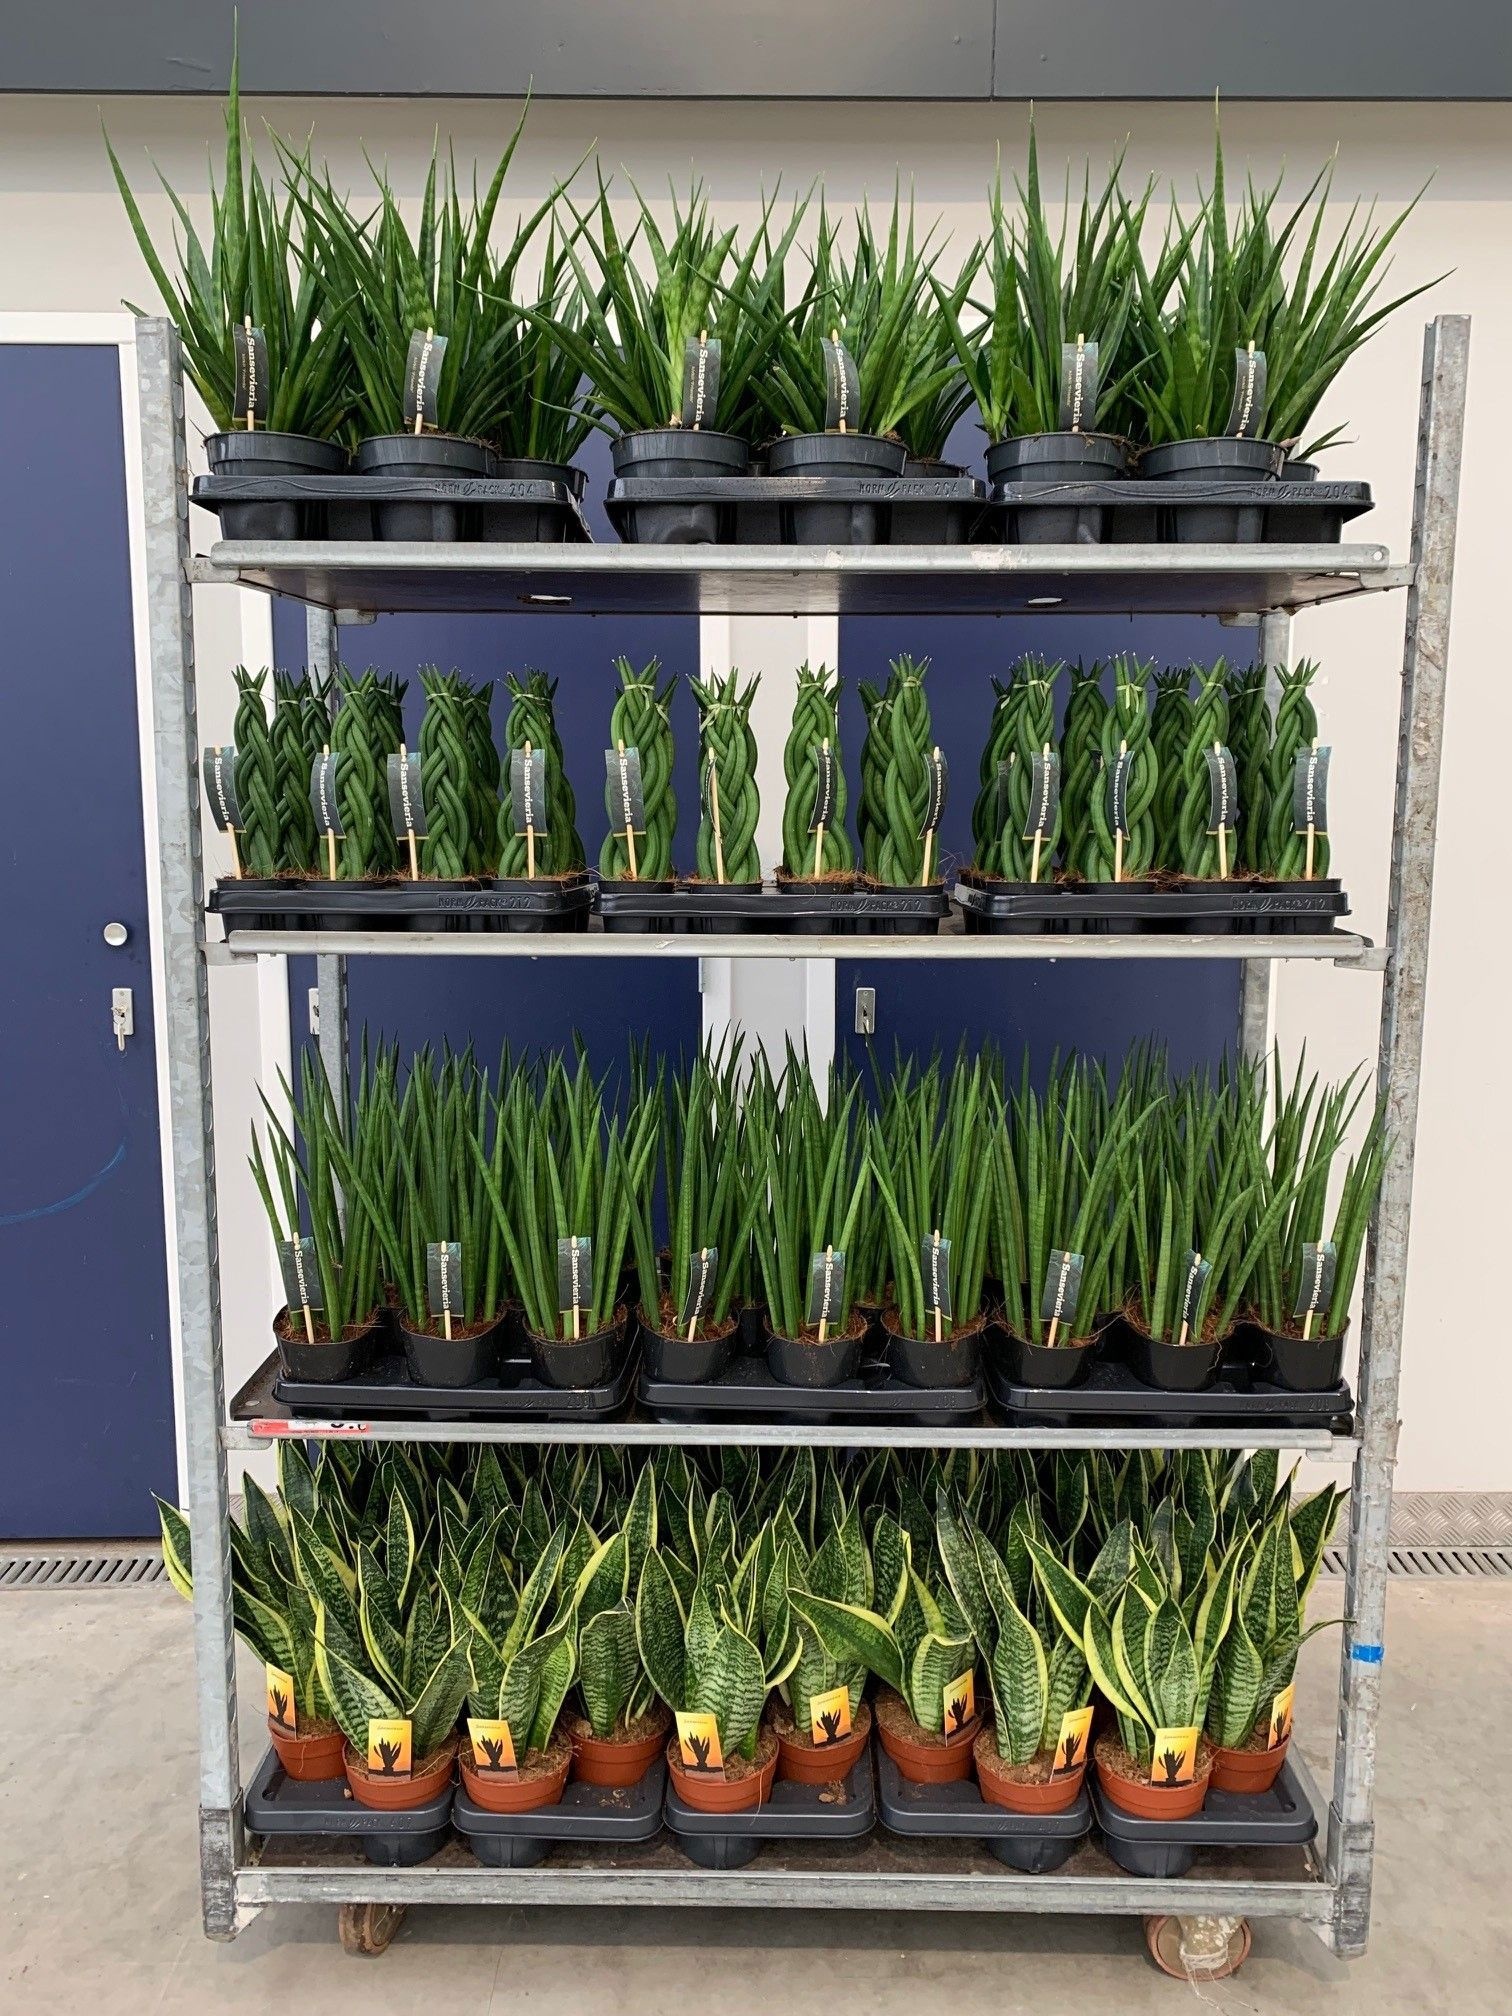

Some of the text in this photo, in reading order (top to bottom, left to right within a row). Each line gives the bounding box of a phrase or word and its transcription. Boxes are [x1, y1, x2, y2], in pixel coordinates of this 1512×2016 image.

[247, 337, 257, 408] Sansevieria
[416, 342, 432, 411] Sansevieria
[695, 348, 708, 421] Sansevieria
[836, 348, 849, 418] Sansevieria
[1072, 353, 1085, 424] Sansevieria
[1239, 359, 1257, 430] Sansevieria
[214, 757, 229, 821] Sansevieria
[319, 762, 330, 827] Sansevieria
[400, 763, 414, 828] Sansevieria
[524, 759, 533, 823] Sansevieria
[619, 758, 634, 823] Sansevieria
[821, 756, 831, 820] Sansevieria
[932, 762, 942, 827] Sansevieria
[1037, 762, 1051, 828] Sansevieria
[1113, 761, 1123, 826] Sansevieria
[1216, 756, 1229, 821] Sansevieria
[1306, 756, 1318, 822] Sansevieria
[294, 1250, 308, 1304] Sansevieria
[440, 1254, 451, 1309] Sansevieria
[571, 1249, 581, 1305] Sansevieria
[694, 1261, 709, 1315] Sansevieria
[821, 1262, 834, 1318] Sansevieria
[931, 1247, 941, 1306] Sansevieria
[1053, 1263, 1071, 1317] Sansevieria
[1182, 1265, 1198, 1319] Sansevieria
[1309, 1253, 1325, 1309] Sansevieria
